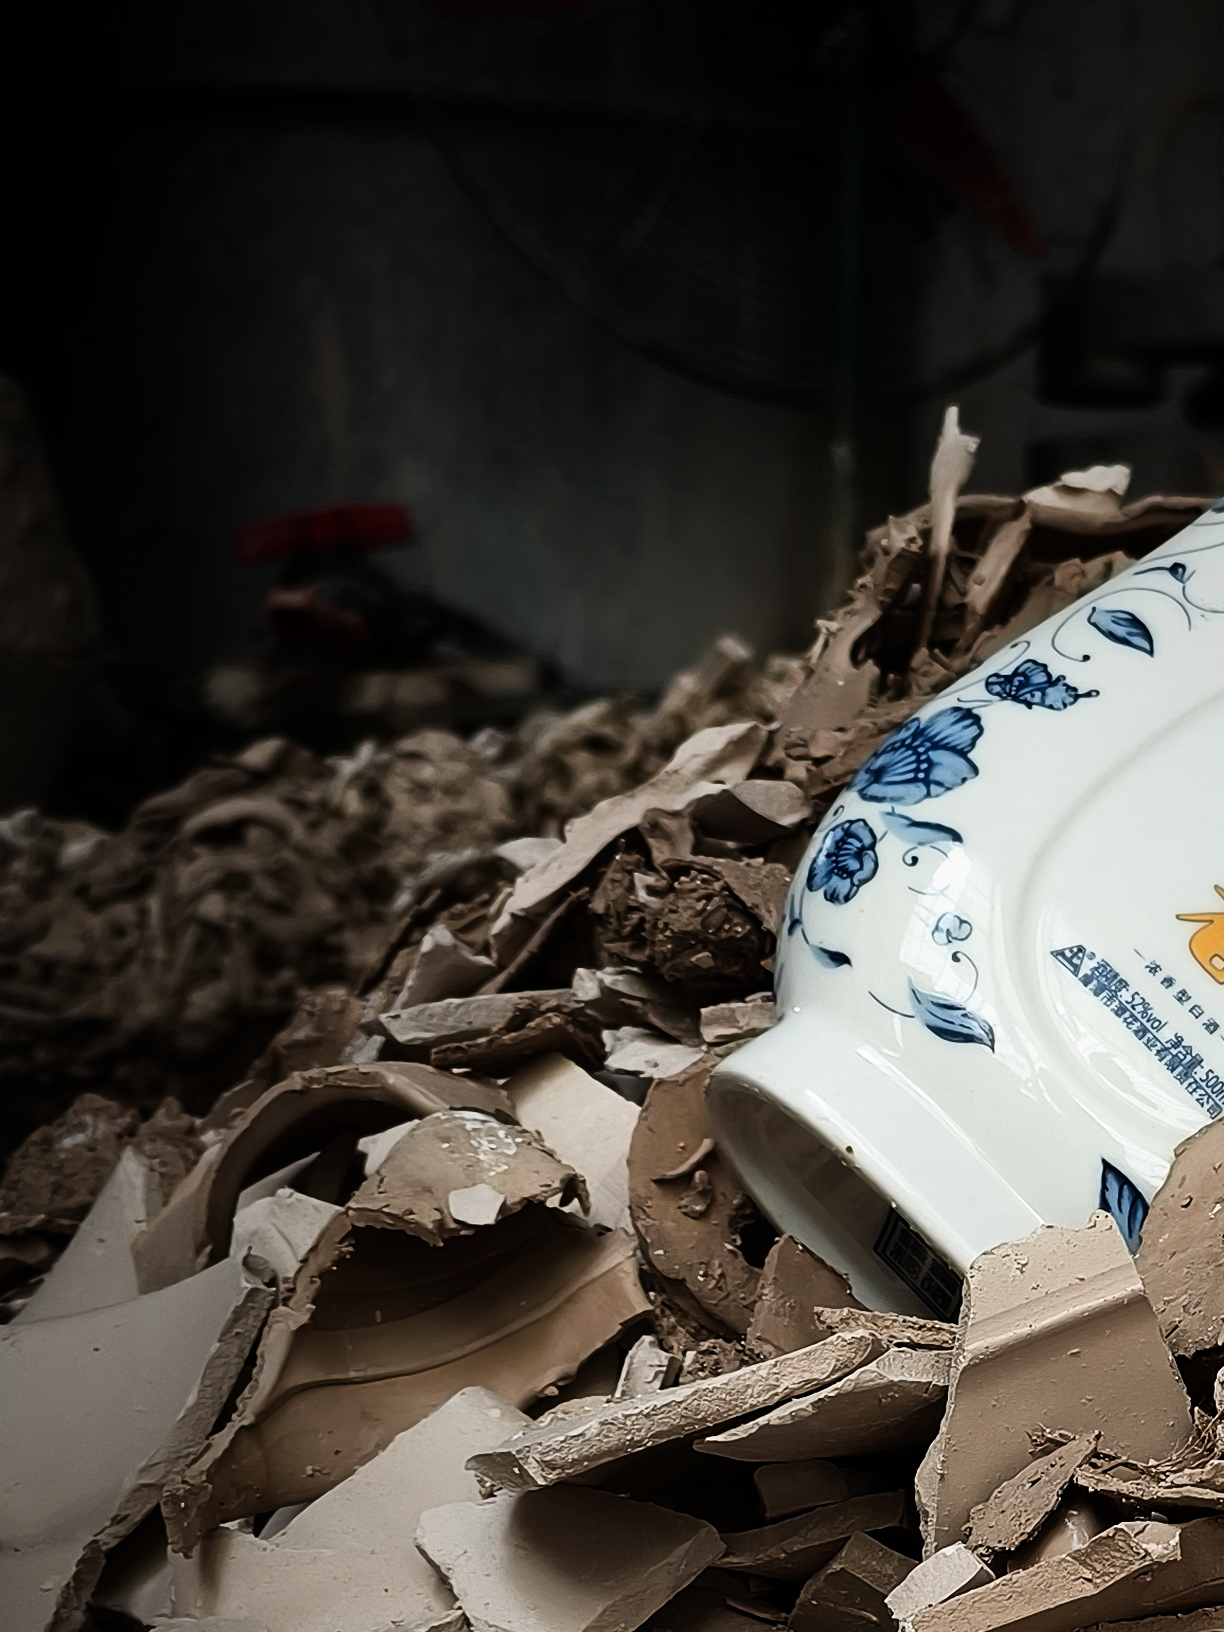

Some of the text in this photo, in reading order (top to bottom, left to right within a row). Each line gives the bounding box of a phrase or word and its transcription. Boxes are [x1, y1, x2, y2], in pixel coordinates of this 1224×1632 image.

[1144, 959, 1221, 1035] 浓香型白酒
